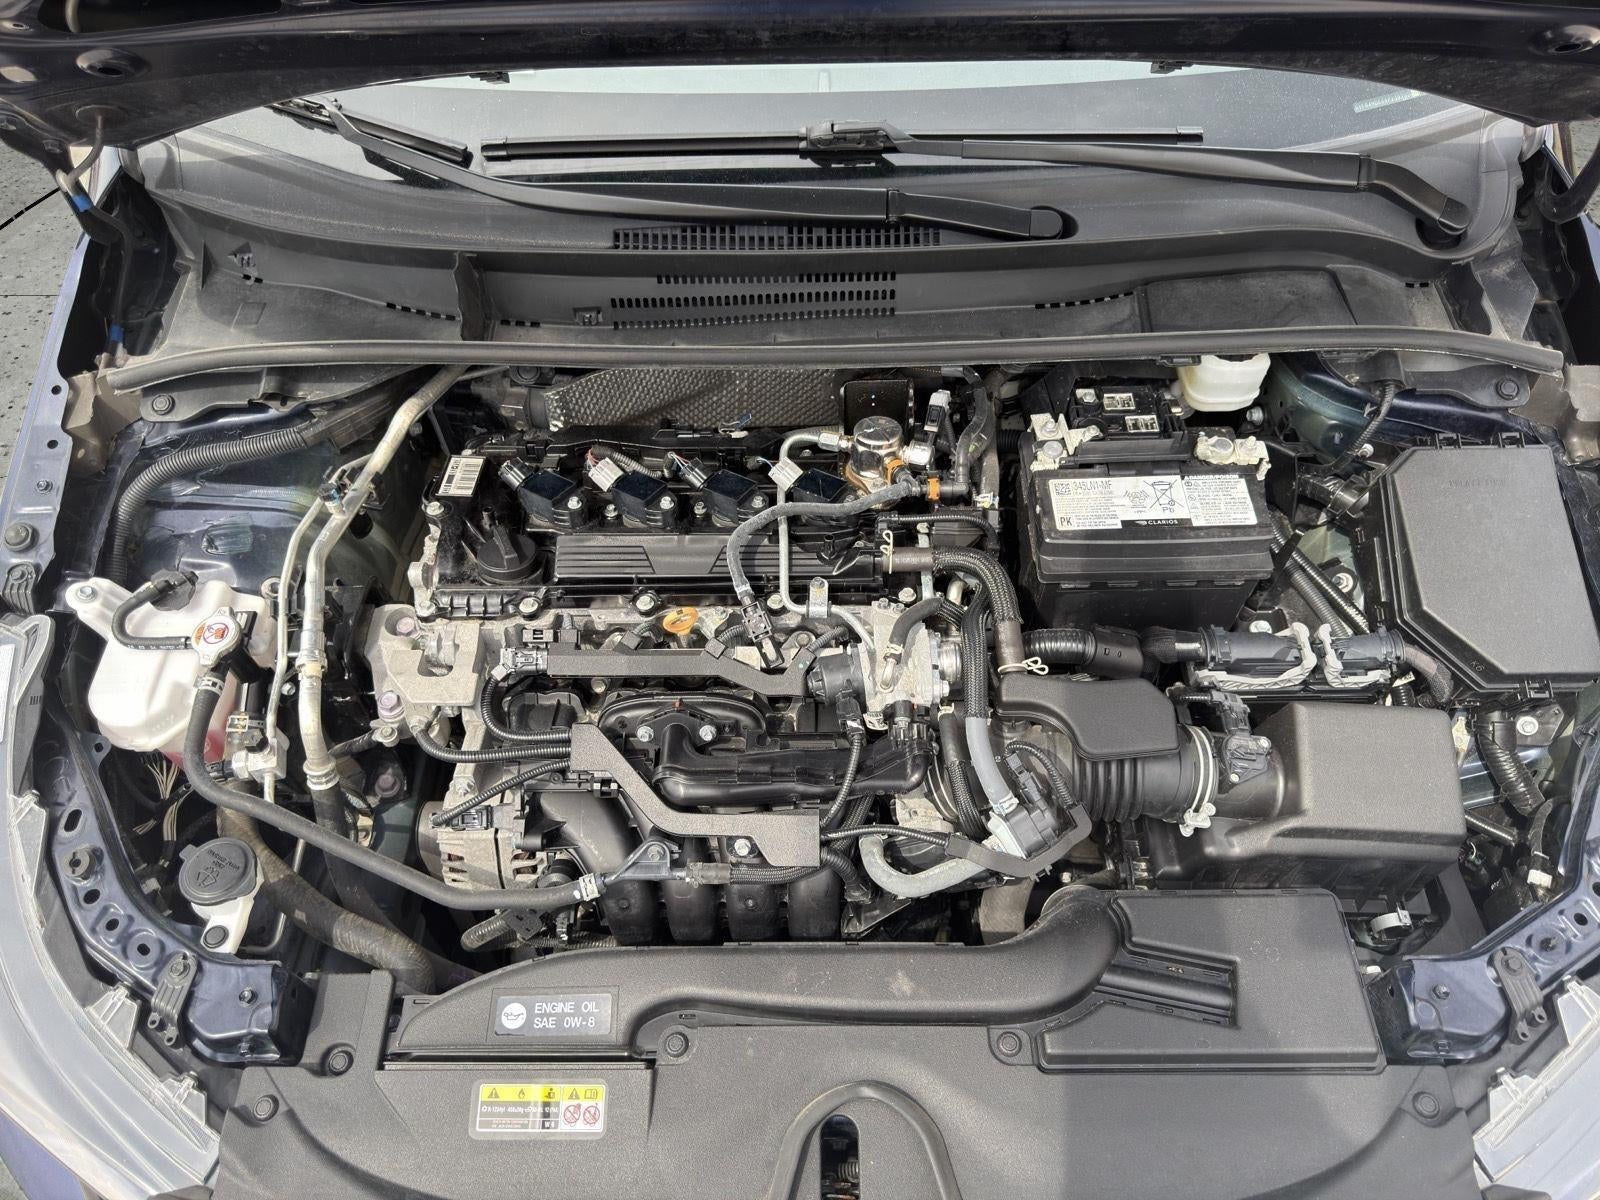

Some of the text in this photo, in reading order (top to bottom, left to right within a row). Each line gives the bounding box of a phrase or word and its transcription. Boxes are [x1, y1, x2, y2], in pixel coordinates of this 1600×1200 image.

[1060, 516, 1073, 527] PK
[534, 1001, 600, 1014] ENGINE OIL
[533, 1016, 596, 1029] SAE 0W-8
